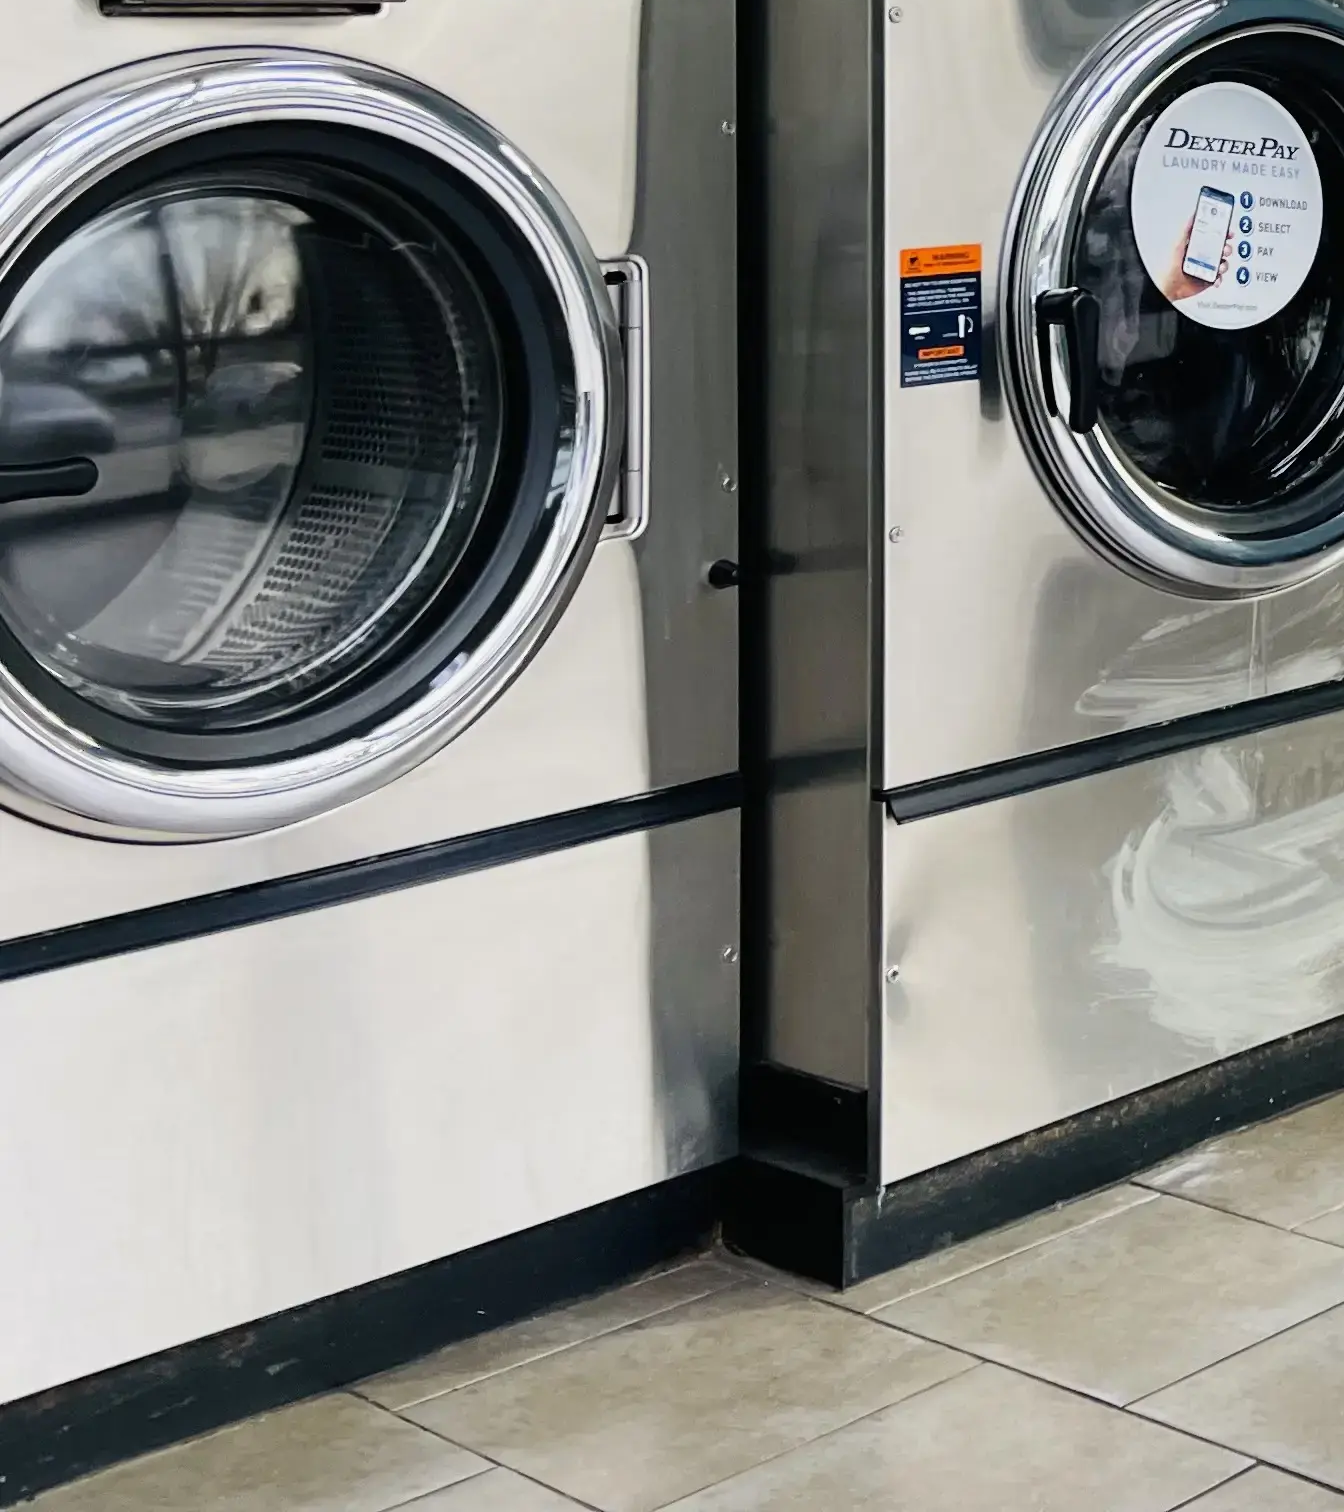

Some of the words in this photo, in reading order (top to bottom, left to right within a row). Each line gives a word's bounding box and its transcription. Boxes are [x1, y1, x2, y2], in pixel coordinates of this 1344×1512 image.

[1162, 154, 1227, 173] LAUNDRY
[1231, 161, 1267, 177] MADE
[1271, 164, 1300, 180] EASY
[1259, 196, 1308, 212] DOWNLOAD
[1257, 221, 1292, 234] SELECT
[1257, 246, 1275, 258] PAY
[1255, 271, 1279, 283] VIEW
